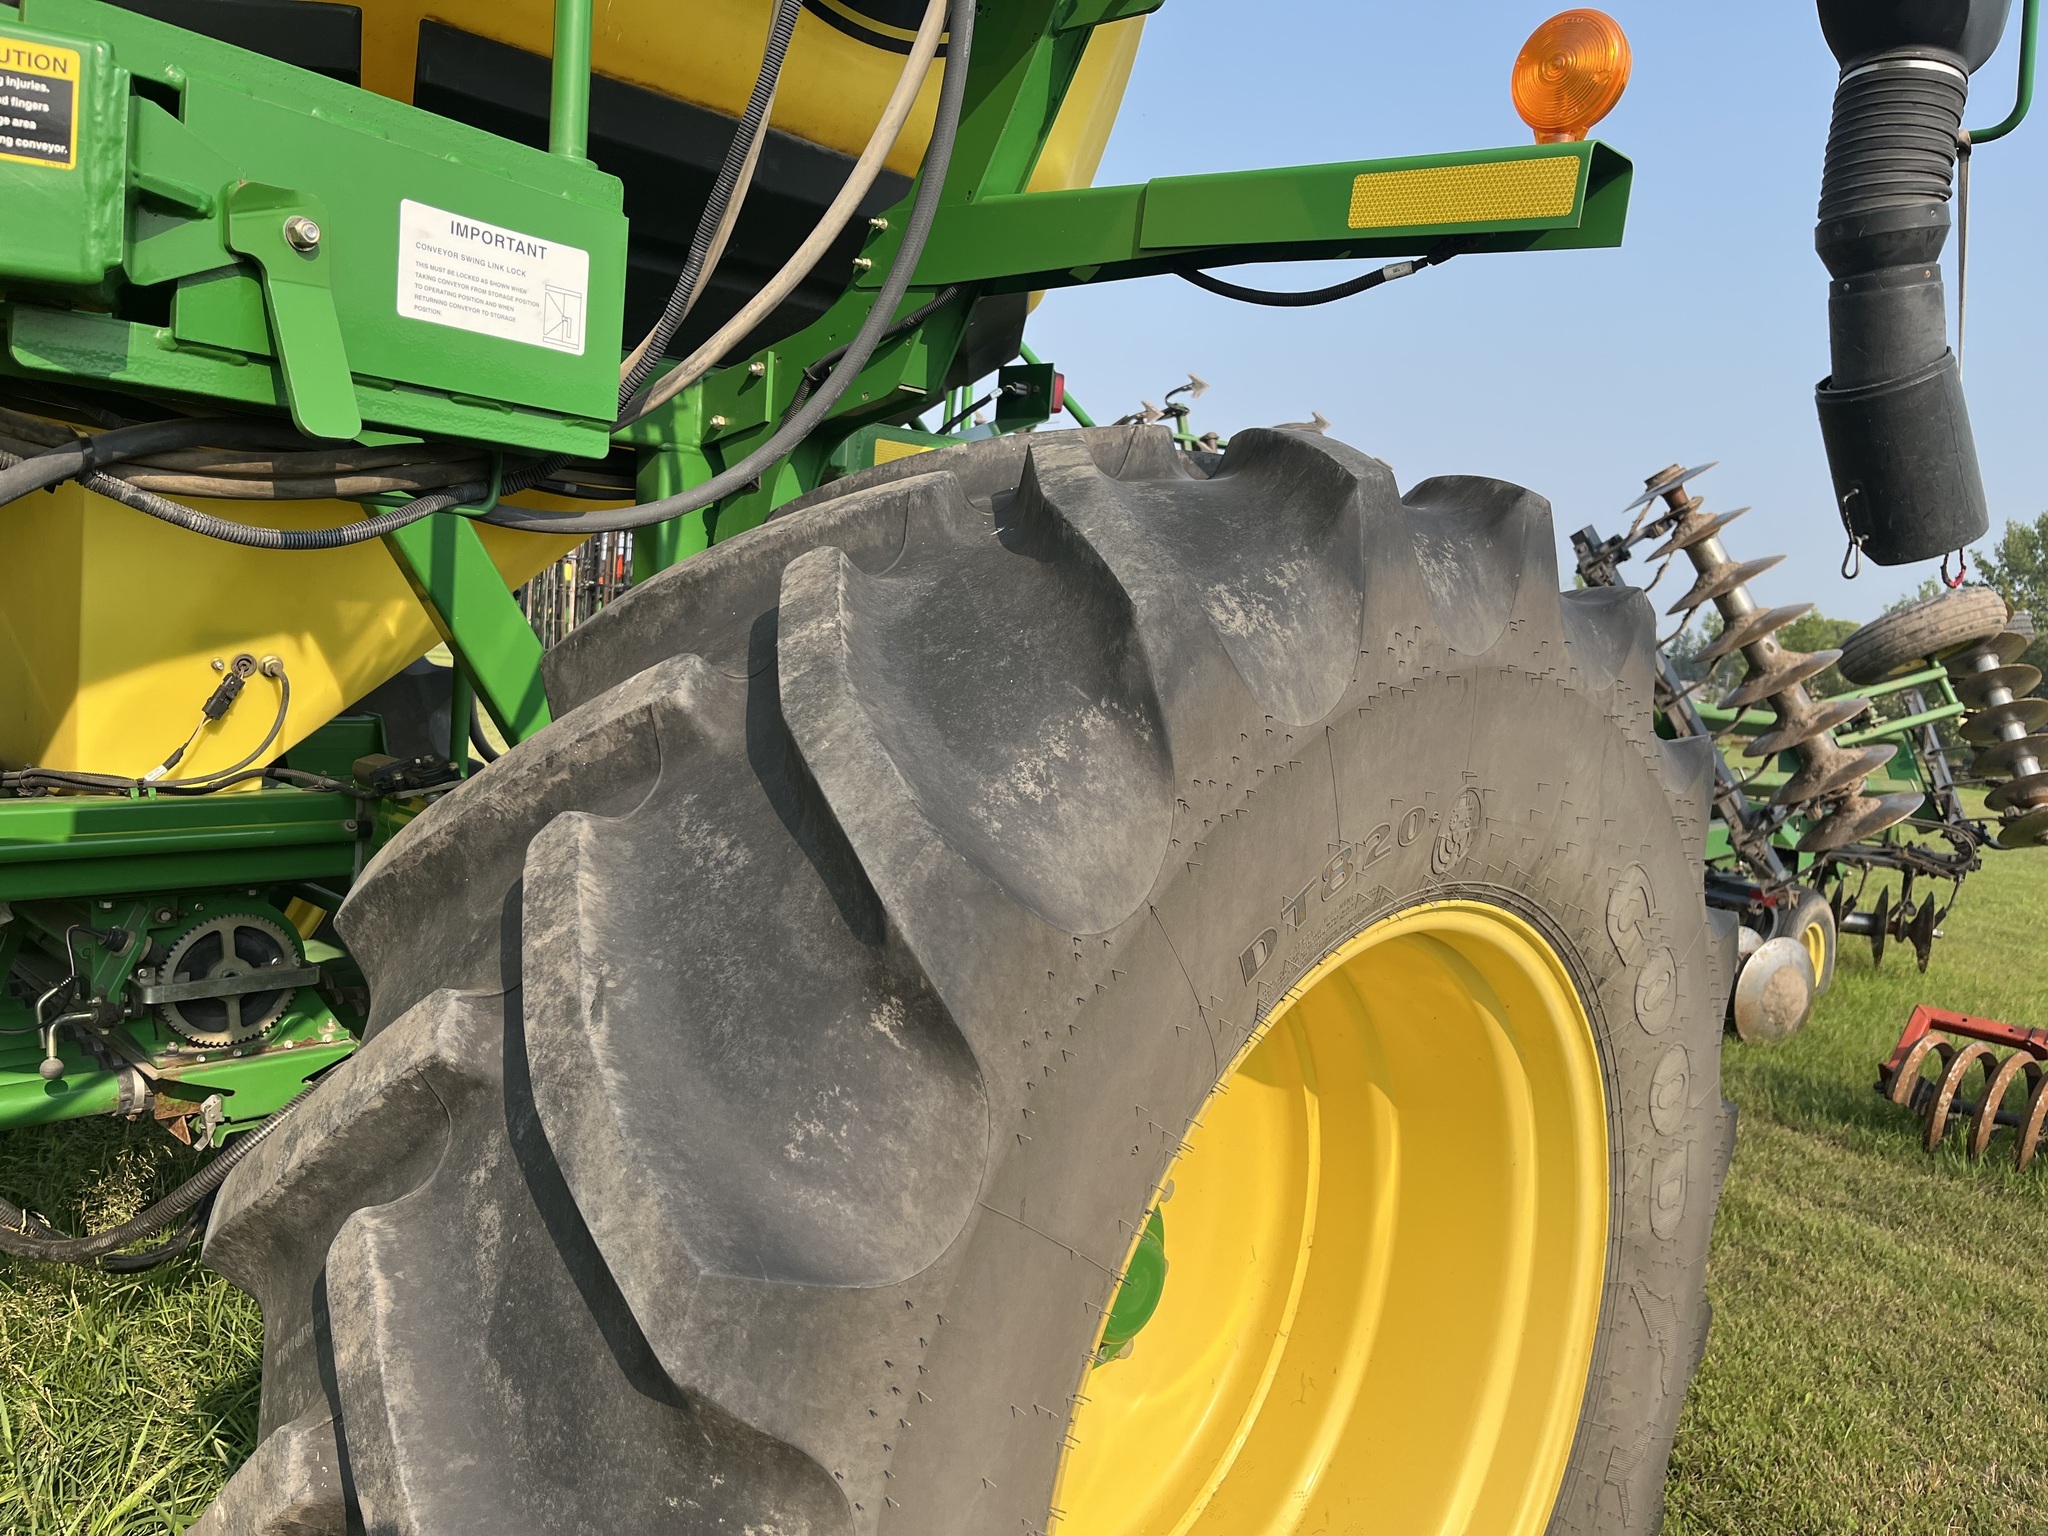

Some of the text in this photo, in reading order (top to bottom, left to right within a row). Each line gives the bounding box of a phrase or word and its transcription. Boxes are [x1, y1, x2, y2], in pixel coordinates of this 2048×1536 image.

[5, 75, 50, 93] injuries.
[11, 96, 50, 112] fingers
[12, 118, 37, 130] area
[15, 138, 68, 155] conveyor.
[450, 220, 548, 260] IMPORTANT
[415, 241, 527, 278] CONVEYOR SWING LINK LOCK
[415, 261, 528, 295] THIS MUST BE LOCKED AS SHOWN WHEN
[415, 271, 540, 308] TAKING CONVEYOR FROM STORAGE POSITION
[414, 293, 517, 323] RETURNING CONVEYOR TO STORAGE
[415, 282, 514, 313] TO OPERATING POSITION AND WHEN
